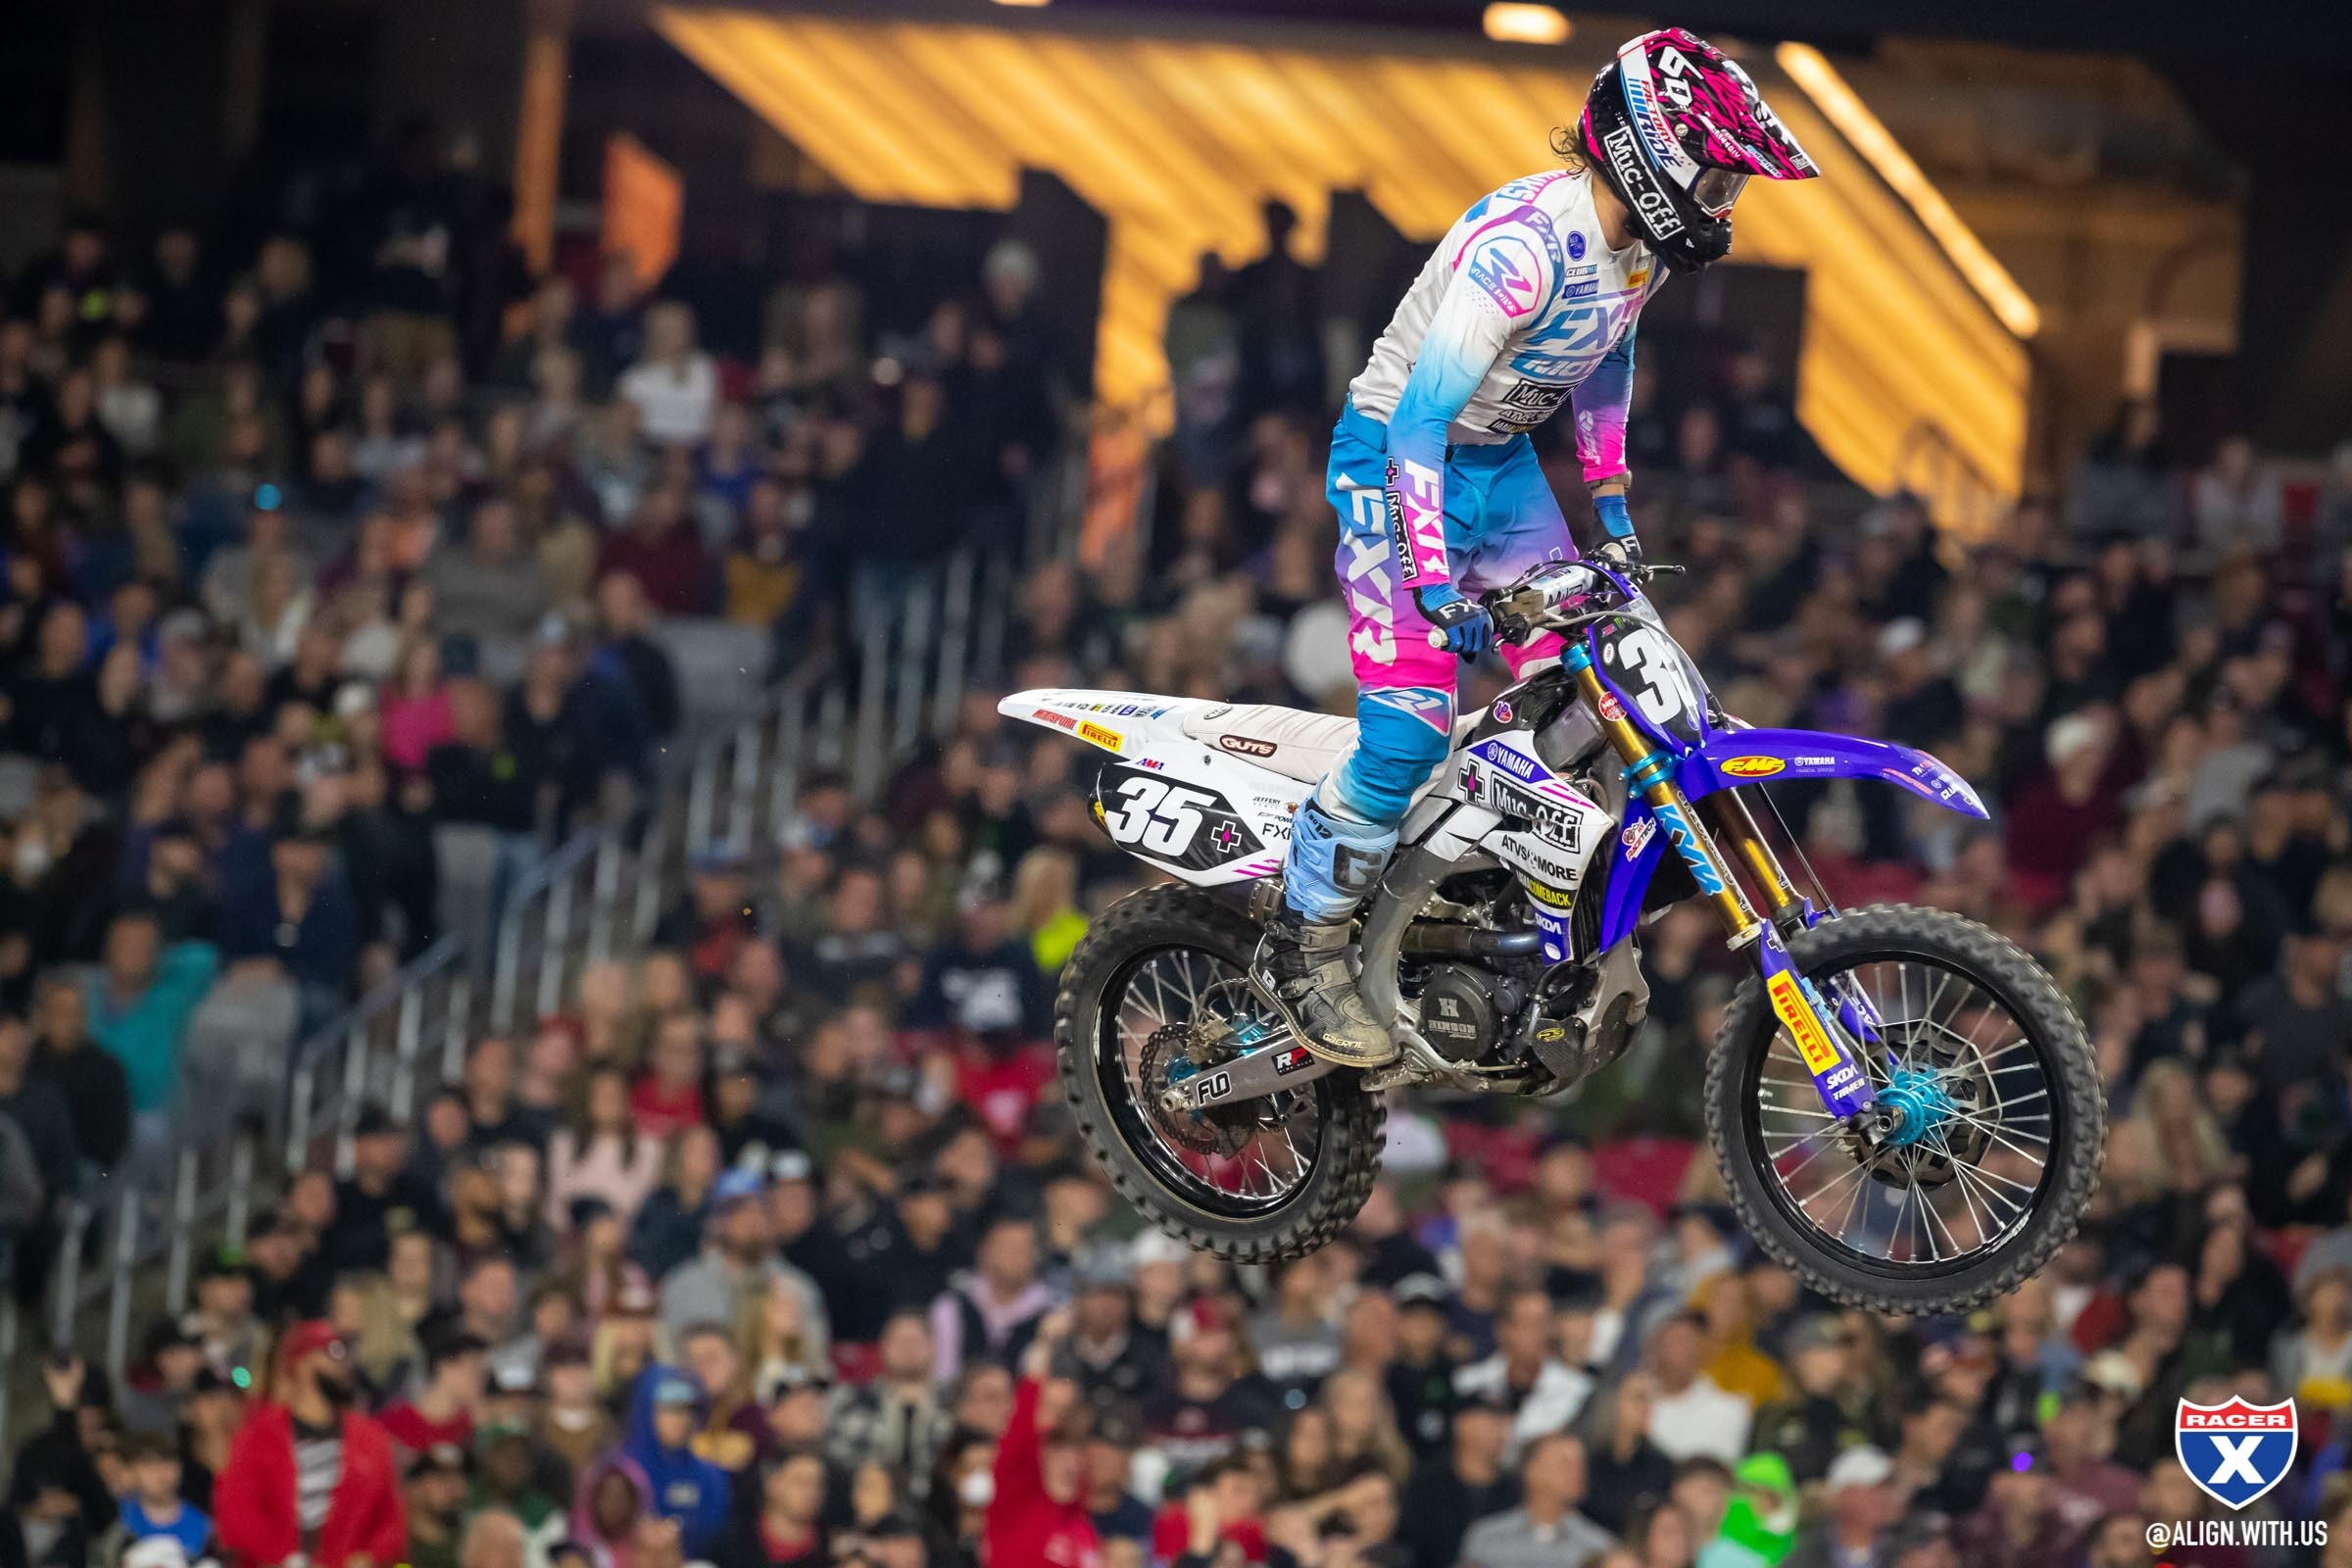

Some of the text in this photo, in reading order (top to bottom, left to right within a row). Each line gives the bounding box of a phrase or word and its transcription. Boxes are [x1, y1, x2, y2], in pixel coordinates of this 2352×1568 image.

[1641, 79, 1674, 146] FACTORY
[1607, 127, 1682, 237] Muc-Off
[1515, 383, 1575, 406] Muc-O
[1387, 492, 1416, 579] Muc-Off
[1439, 598, 1484, 619] FX
[1081, 723, 1119, 749] PIRELLI
[1221, 736, 1274, 755] GUTS
[1136, 758, 1165, 770] AMA
[1495, 746, 1537, 779] YAMAHA
[1721, 757, 1785, 774] FMF
[1803, 757, 1836, 766] YAMAHA
[1252, 796, 1282, 806] JEFFERY
[1103, 776, 1218, 858] 35
[1653, 804, 1724, 896] KYB
[1772, 980, 1831, 1064] PIRELLI
[1197, 1074, 1230, 1105] FLO
[1826, 1064, 1859, 1090] SKDA
